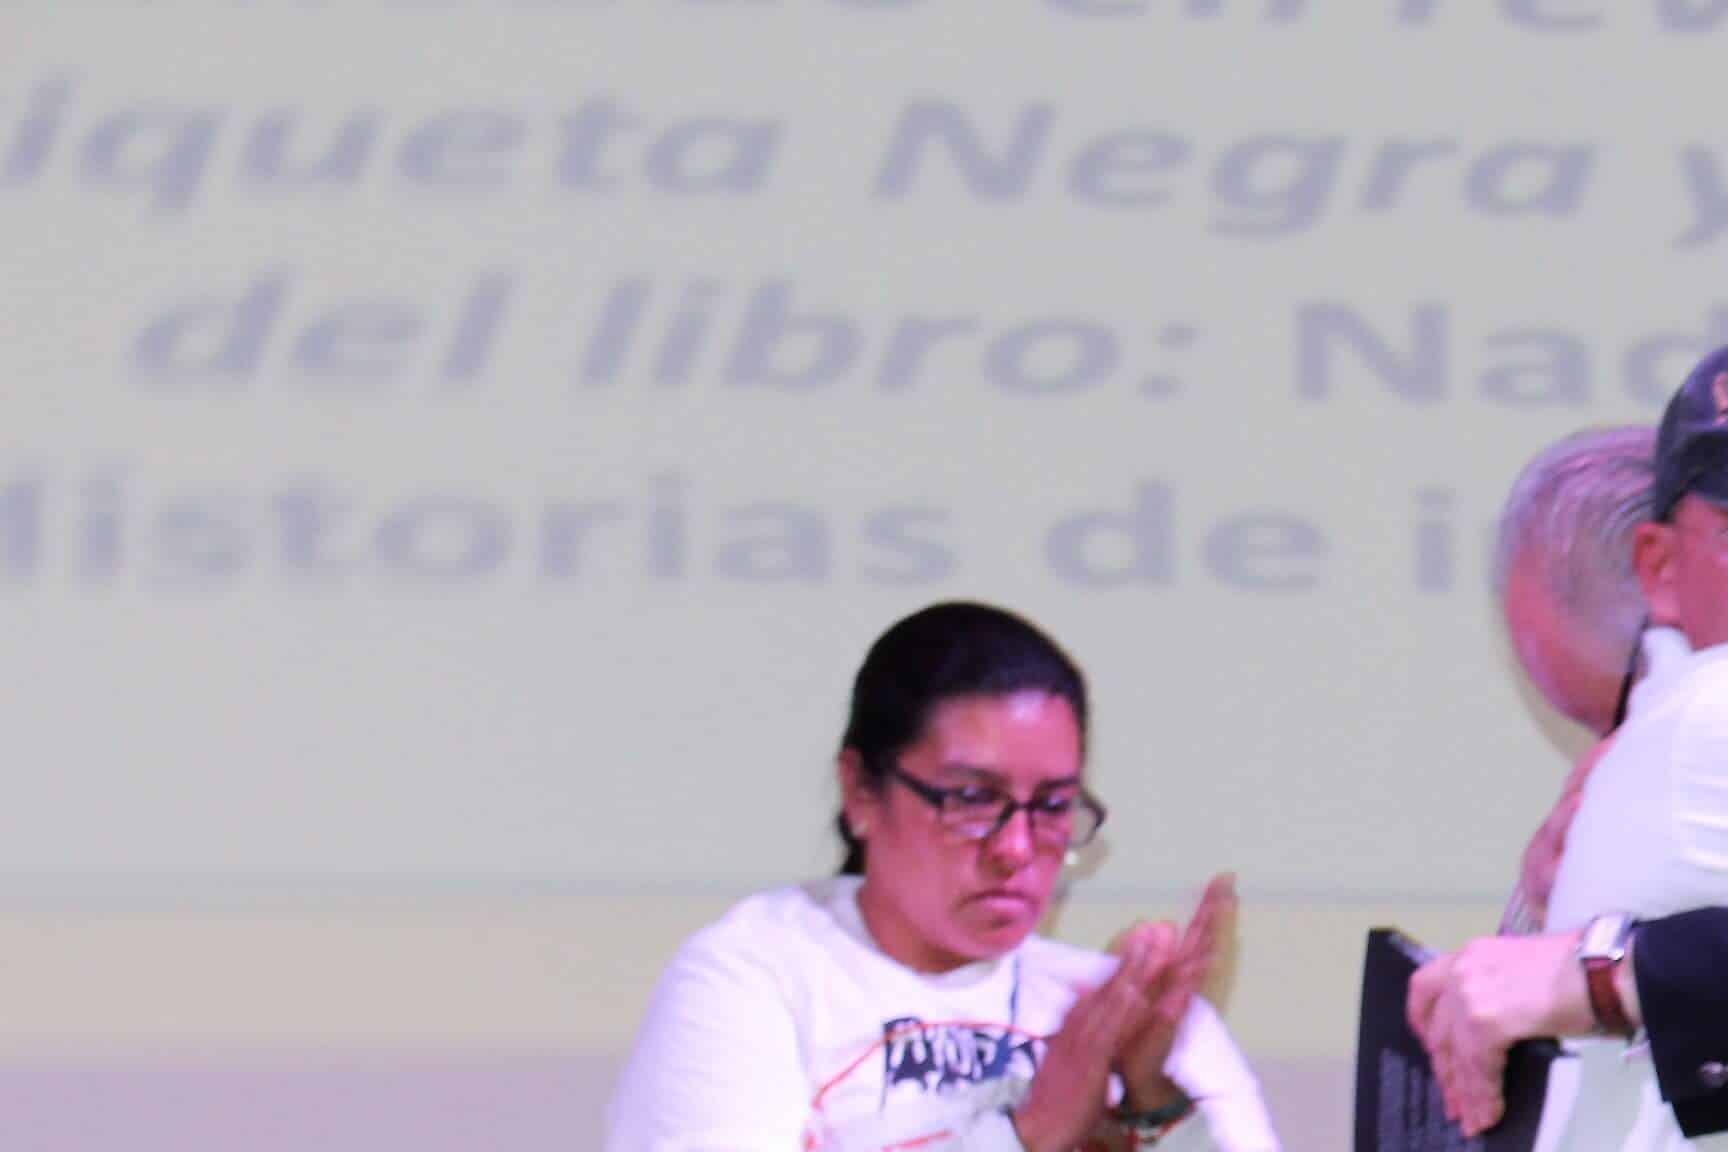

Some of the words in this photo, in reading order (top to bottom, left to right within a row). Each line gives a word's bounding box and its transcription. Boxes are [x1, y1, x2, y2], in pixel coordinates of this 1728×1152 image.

[867, 92, 1594, 238] Negra
[127, 268, 516, 387] del
[579, 273, 1196, 397] libro:
[1043, 478, 1327, 595] de
